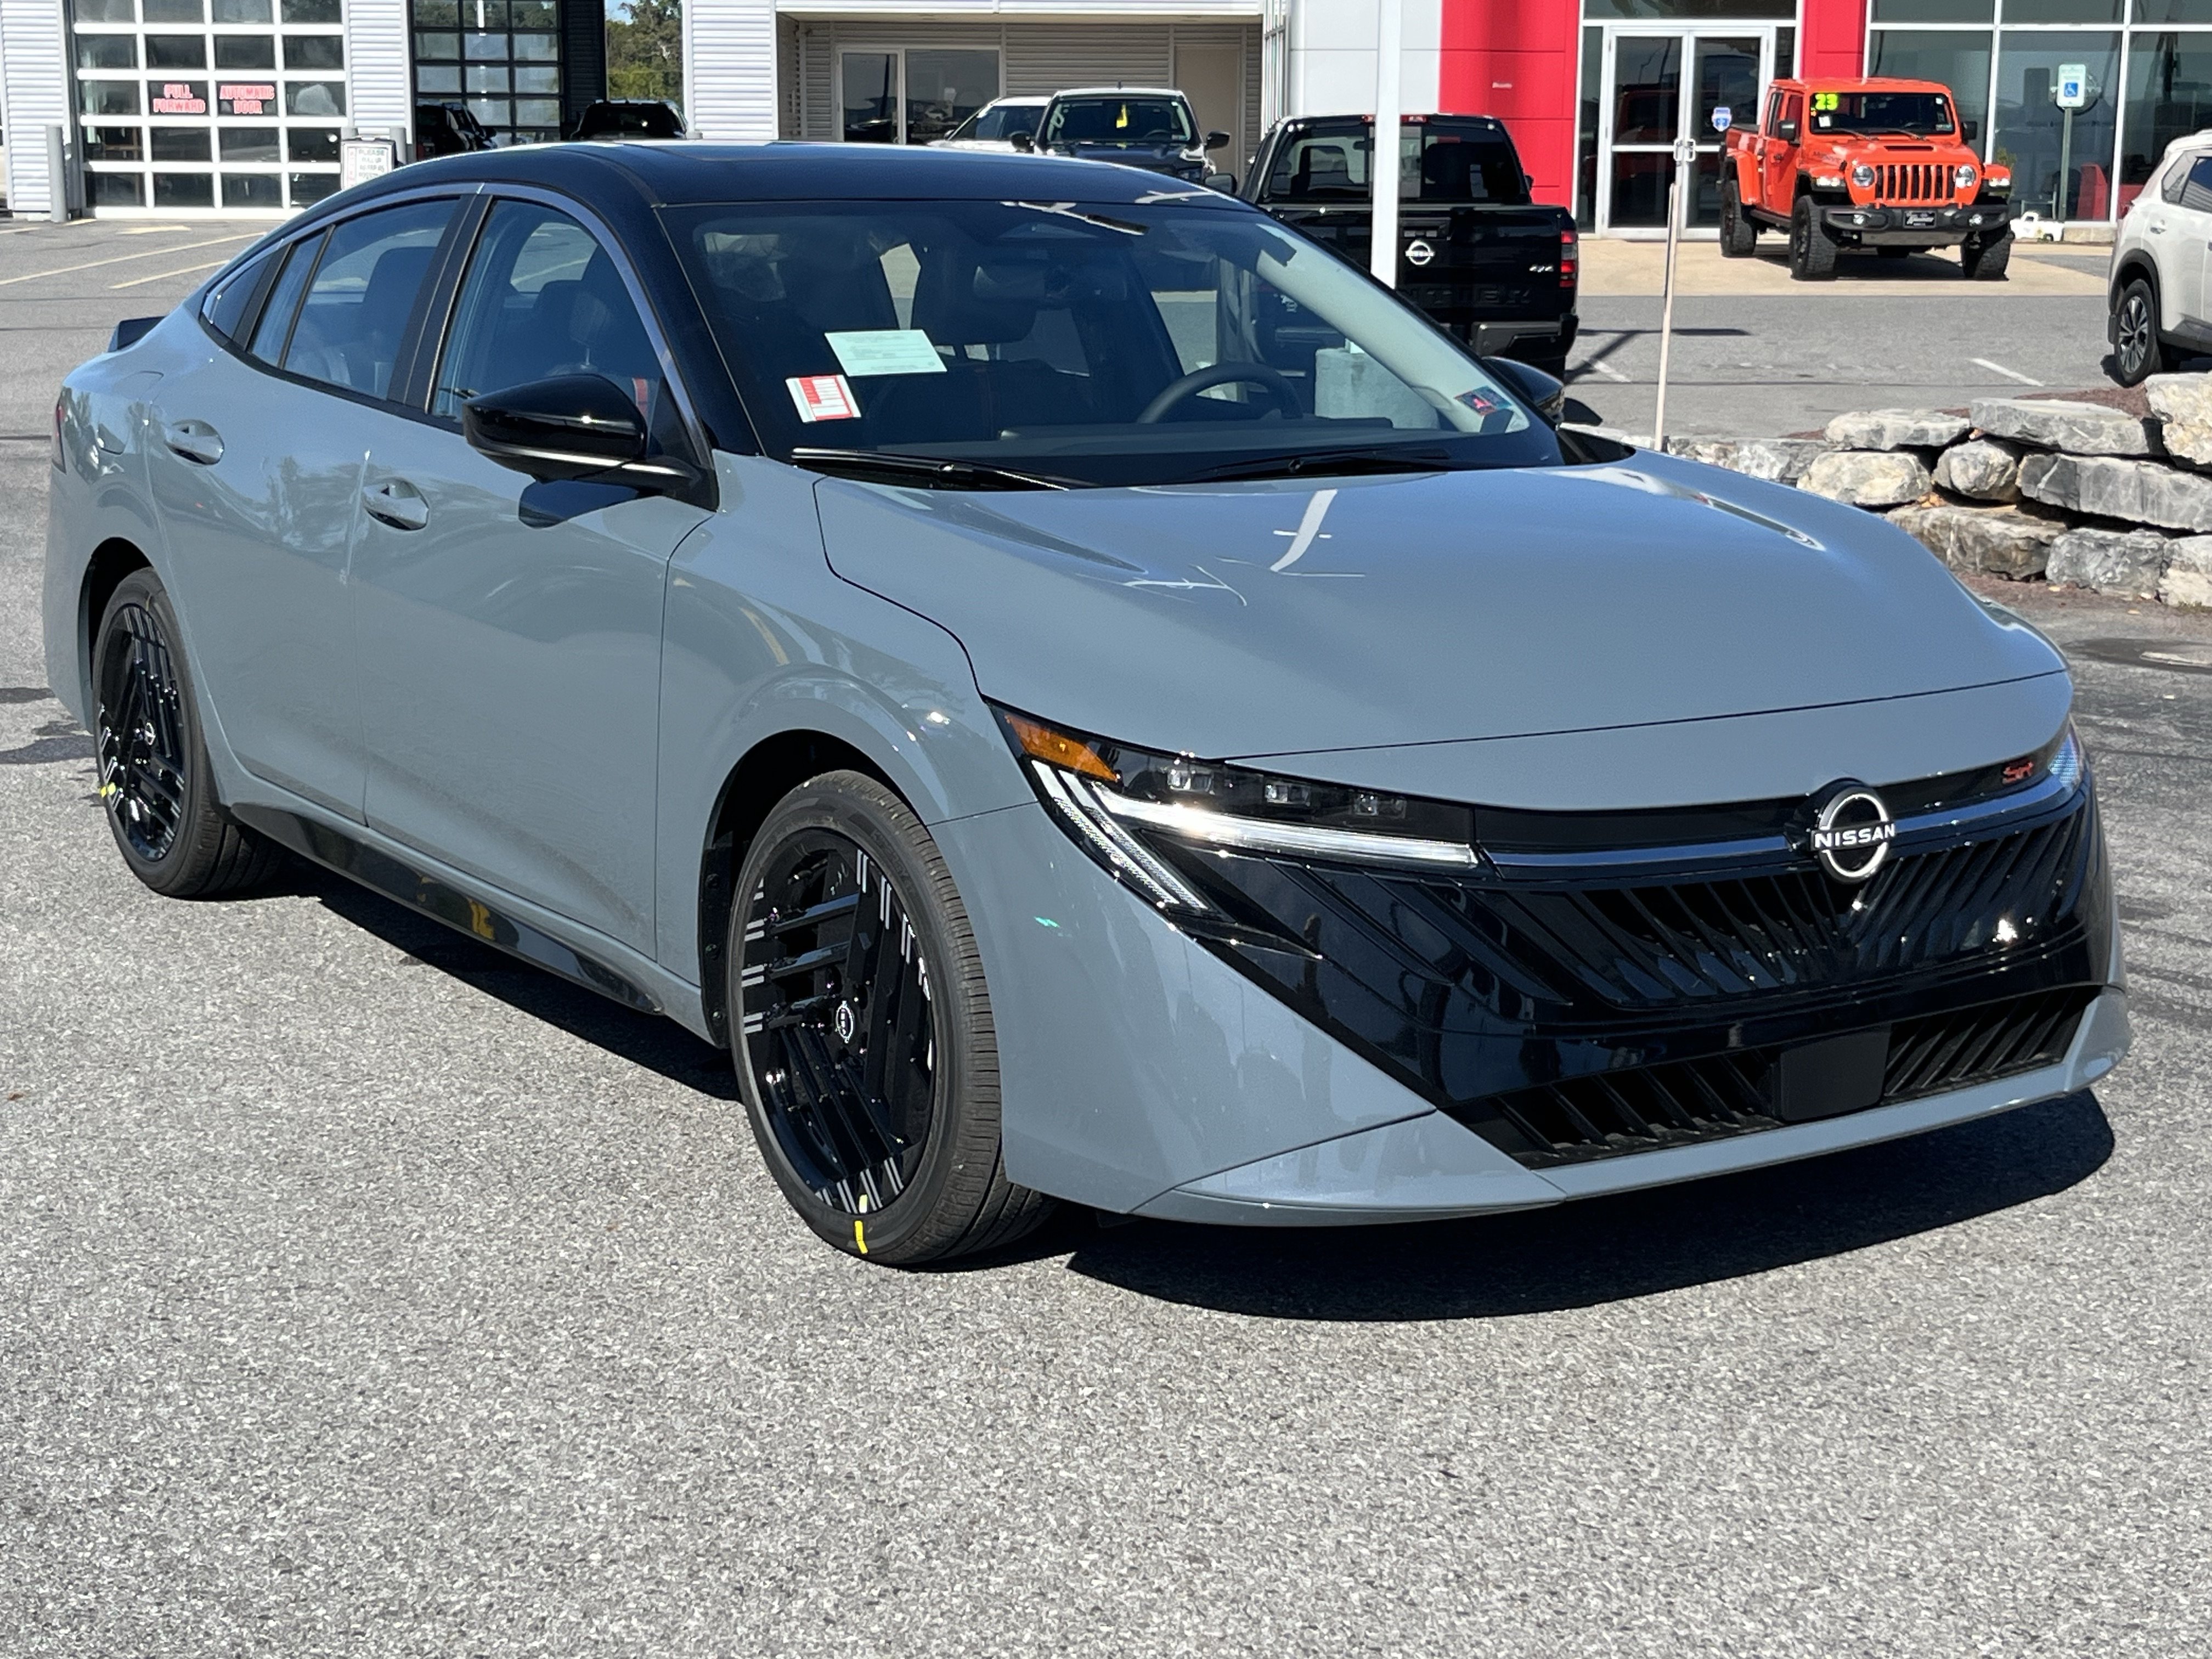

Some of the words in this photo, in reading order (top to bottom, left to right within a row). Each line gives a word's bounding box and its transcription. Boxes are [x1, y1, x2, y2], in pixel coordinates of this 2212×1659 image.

[164, 84, 193, 98] PULL
[219, 85, 275, 99] AUTOMATIC
[153, 98, 206, 113] FORWARD
[233, 100, 263, 114] DOOR
[1815, 93, 1838, 110] 23
[1814, 823, 1895, 848] NISSAN
